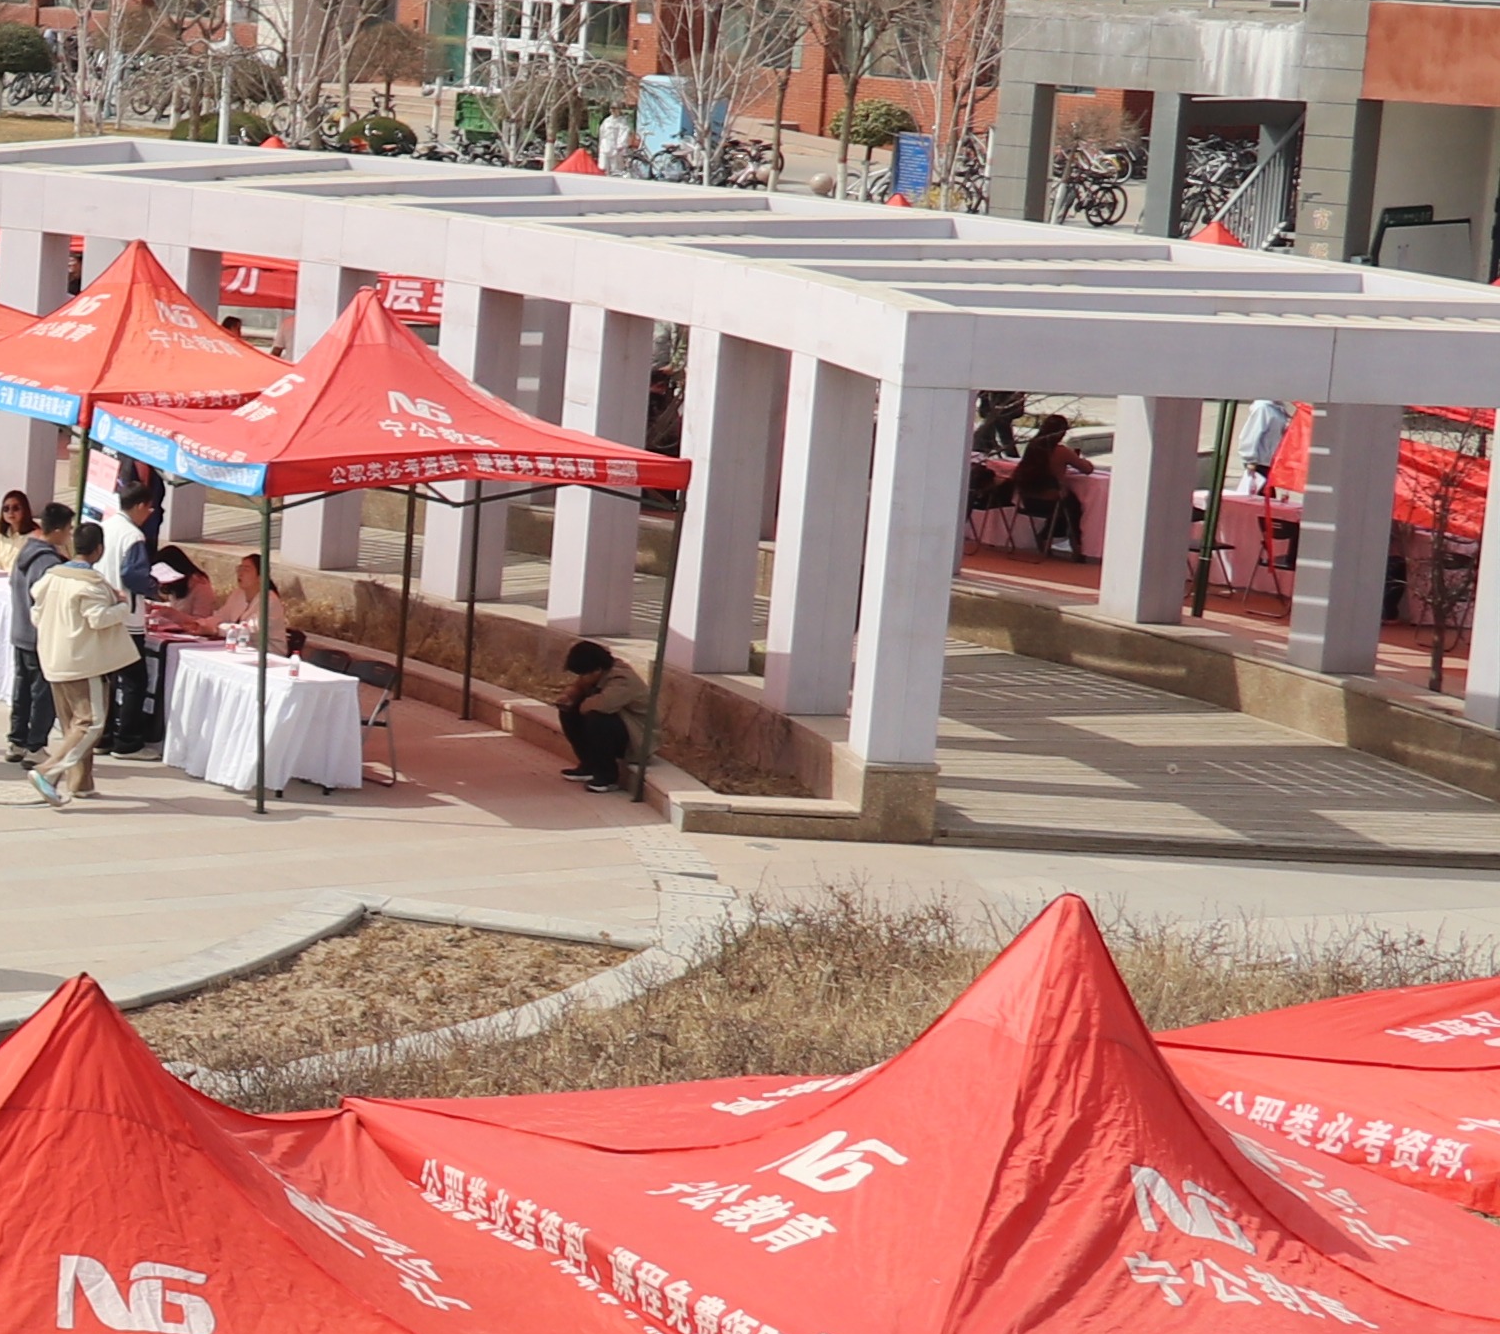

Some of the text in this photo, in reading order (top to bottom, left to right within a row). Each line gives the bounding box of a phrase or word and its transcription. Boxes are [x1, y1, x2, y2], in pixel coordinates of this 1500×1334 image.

[388, 391, 454, 425] NG
[1122, 1250, 1380, 1329] 宁公教育
